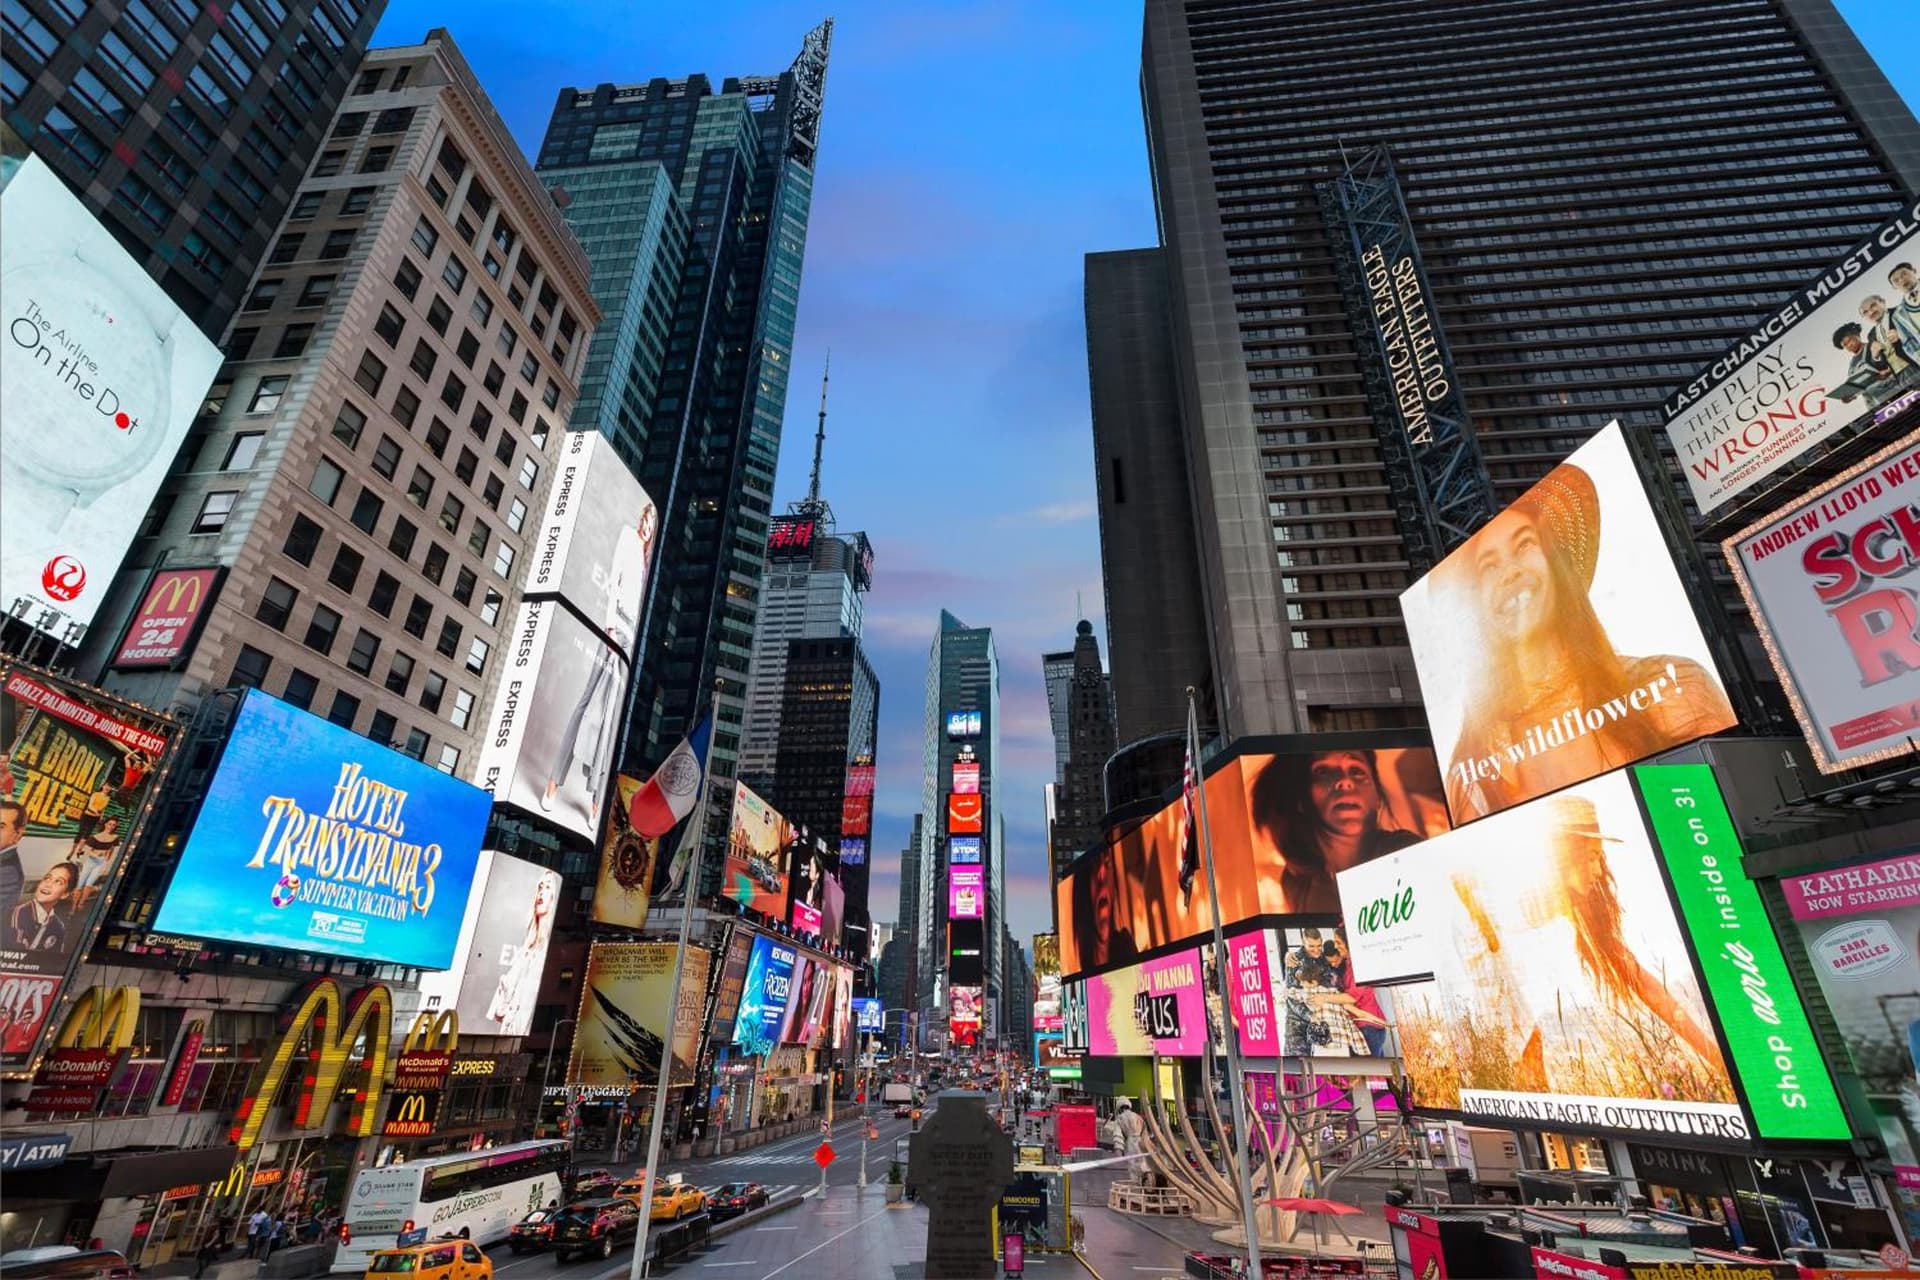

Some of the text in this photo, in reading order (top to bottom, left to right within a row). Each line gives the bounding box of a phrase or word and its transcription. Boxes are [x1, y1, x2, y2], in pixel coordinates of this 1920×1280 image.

[20, 299, 99, 377] The Airline,
[1361, 244, 1433, 445] AMERICAN EAGLE
[1392, 256, 1449, 402] OUTFITTERS
[1664, 373, 1710, 417] LAST
[1712, 301, 1804, 381] CHANCE!
[1806, 242, 1880, 306] MUST
[10, 317, 52, 368] On
[56, 358, 95, 402] the
[1683, 356, 1815, 457] THAT GOES
[1684, 344, 1787, 434] THE PLAY
[1690, 387, 1828, 482] WRONG
[1722, 433, 1806, 491] LONGEST-RUNNING
[1807, 420, 1828, 437] PLAY
[1761, 422, 1807, 456] FUNNIEST
[554, 466, 576, 517] EXPRESS
[1821, 476, 1884, 524] LLOYD
[537, 526, 560, 584] EXPRESS
[137, 629, 174, 647] 24
[142, 616, 187, 630] OPEN
[516, 601, 542, 667] EXPRESS
[121, 646, 178, 661] HOURS
[8, 678, 165, 753] CHAZZ PALMINTERI JOINS THE CAST!
[496, 680, 521, 747] EXPRESS
[1454, 663, 1683, 787] Hey wildflower!
[17, 716, 104, 793] A BRONX
[19, 769, 73, 826] TALE
[326, 762, 408, 838] HOTEL
[1671, 787, 1696, 808] 3!
[1688, 817, 1710, 846] on
[246, 795, 443, 920] TRANSYLVANIA 3
[299, 879, 409, 922] SUMMER VACATION
[1357, 878, 1416, 936] aerie
[1700, 855, 1741, 929] inside
[1806, 895, 1843, 912] NOW
[1238, 945, 1258, 968] ARE
[1832, 943, 1891, 969] BAREILLES
[1839, 939, 1869, 954] SARA
[763, 968, 792, 1001] FROZEN
[1152, 963, 1195, 992] WANNA
[1240, 970, 1262, 991] YOU
[1240, 993, 1268, 1016] WITH
[1247, 1018, 1268, 1040] US?
[43, 1059, 111, 1073] McDonald's
[399, 1058, 449, 1067] McDonald's
[452, 1061, 495, 1075] EXPRESS
[1461, 1095, 1751, 1140] AMERICAN EAGLE OUTFITTERS
[24, 1144, 66, 1161] ATM
[1641, 1147, 1714, 1176] DRINK
[1536, 1255, 1573, 1275] belgian
